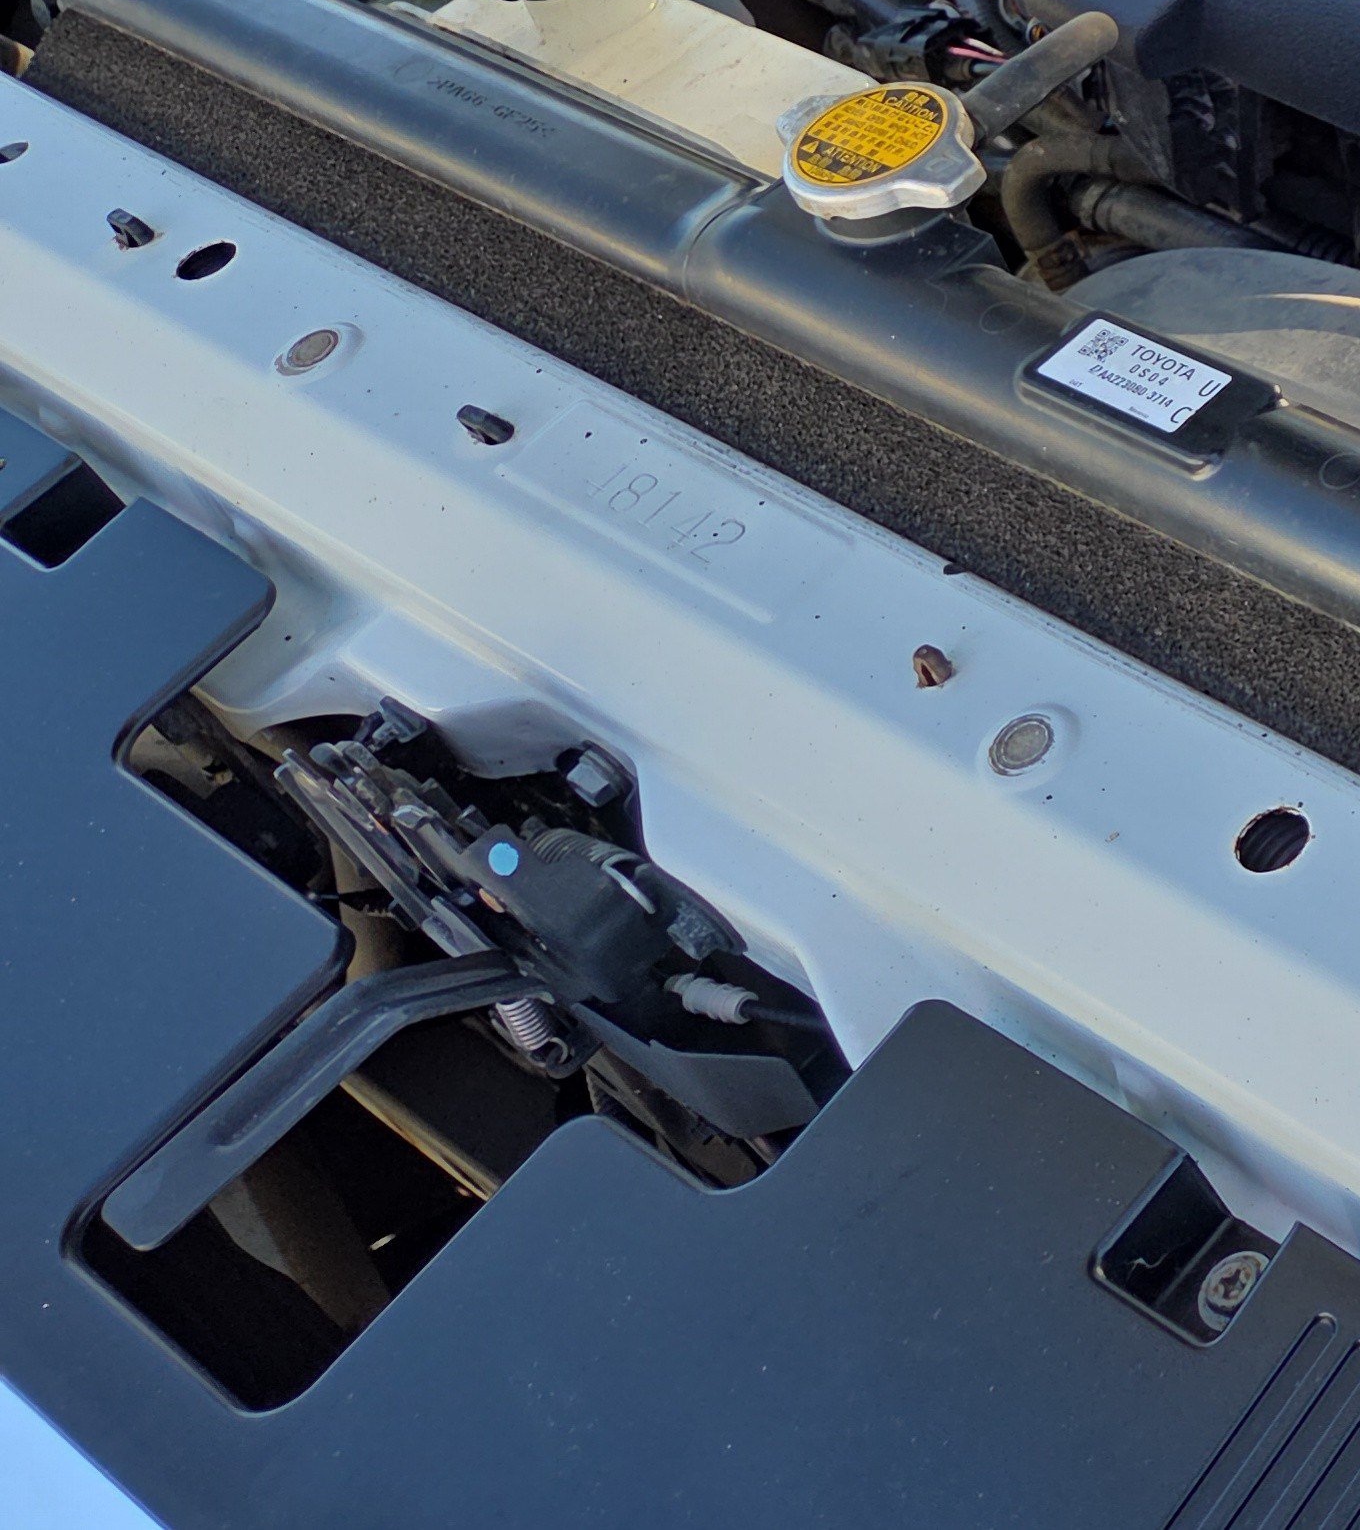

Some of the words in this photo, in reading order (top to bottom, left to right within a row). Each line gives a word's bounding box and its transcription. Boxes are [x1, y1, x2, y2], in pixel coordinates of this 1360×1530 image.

[884, 96, 940, 121] CAUTION
[1130, 344, 1196, 381] TOYOTA
[1170, 406, 1193, 424] C
